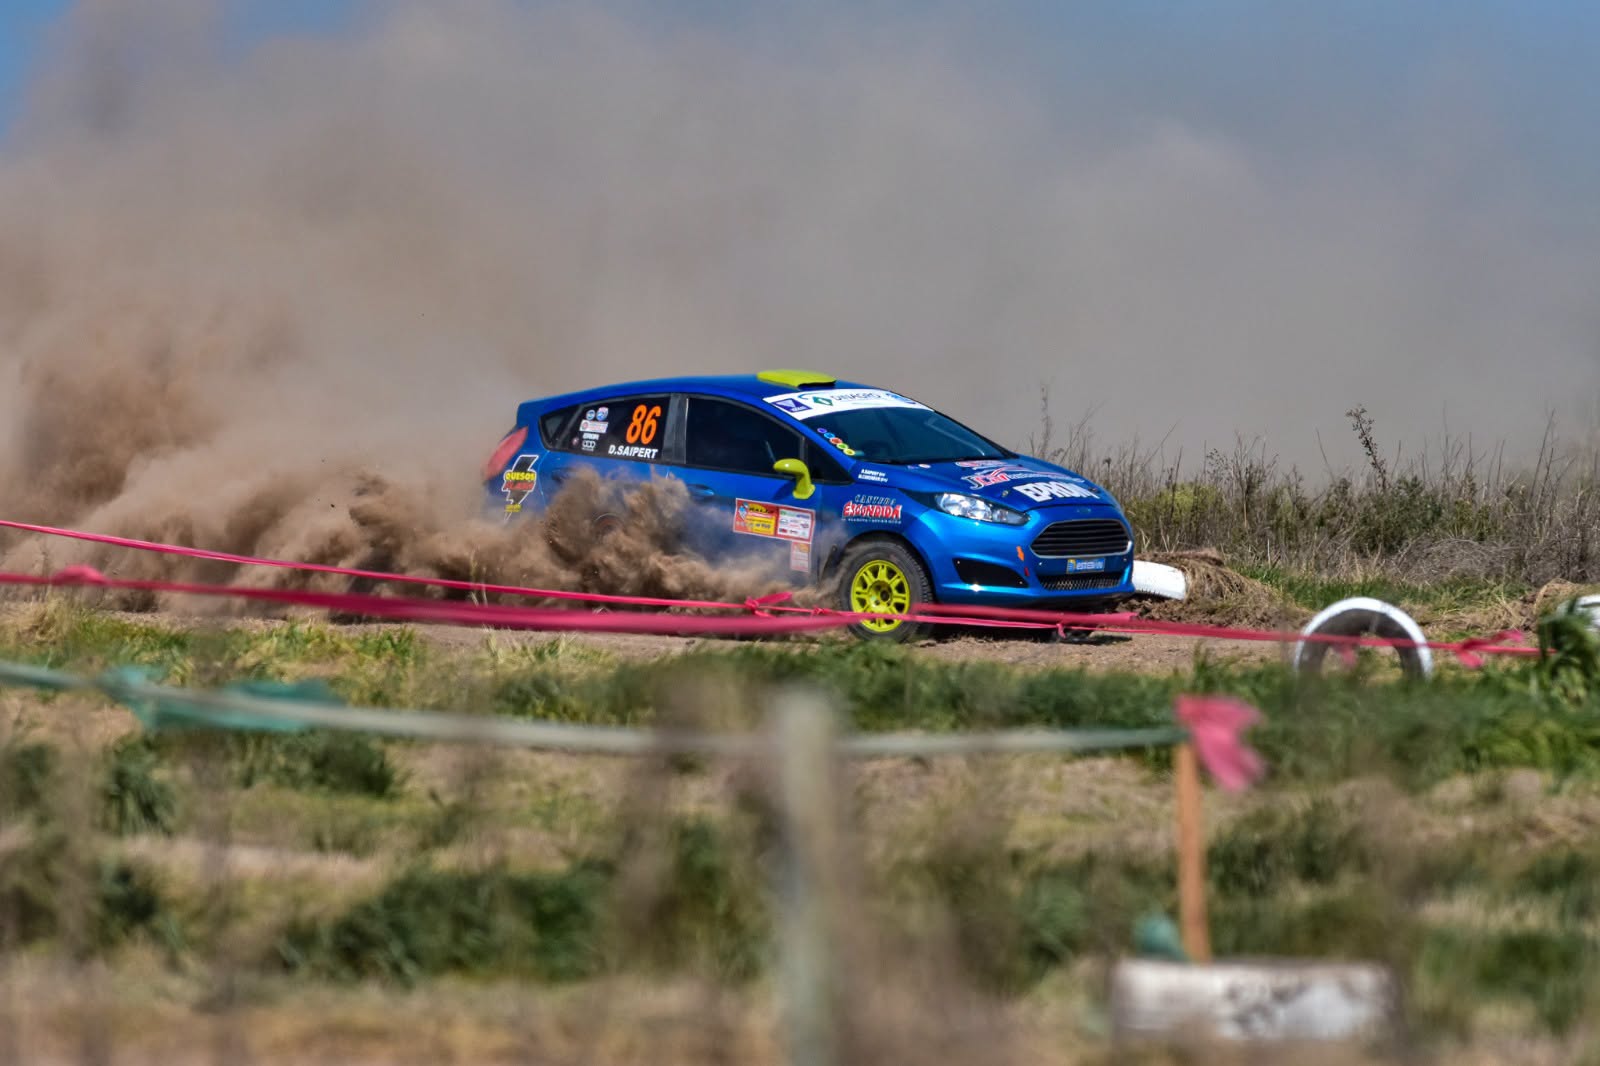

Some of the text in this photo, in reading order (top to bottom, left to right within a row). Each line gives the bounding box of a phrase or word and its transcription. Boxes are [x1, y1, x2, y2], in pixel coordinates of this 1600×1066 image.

[626, 404, 662, 445] 86
[608, 444, 659, 459] D.SAIPERT
[505, 471, 536, 481] QUESOS
[842, 500, 903, 519] ESCONDIDA
